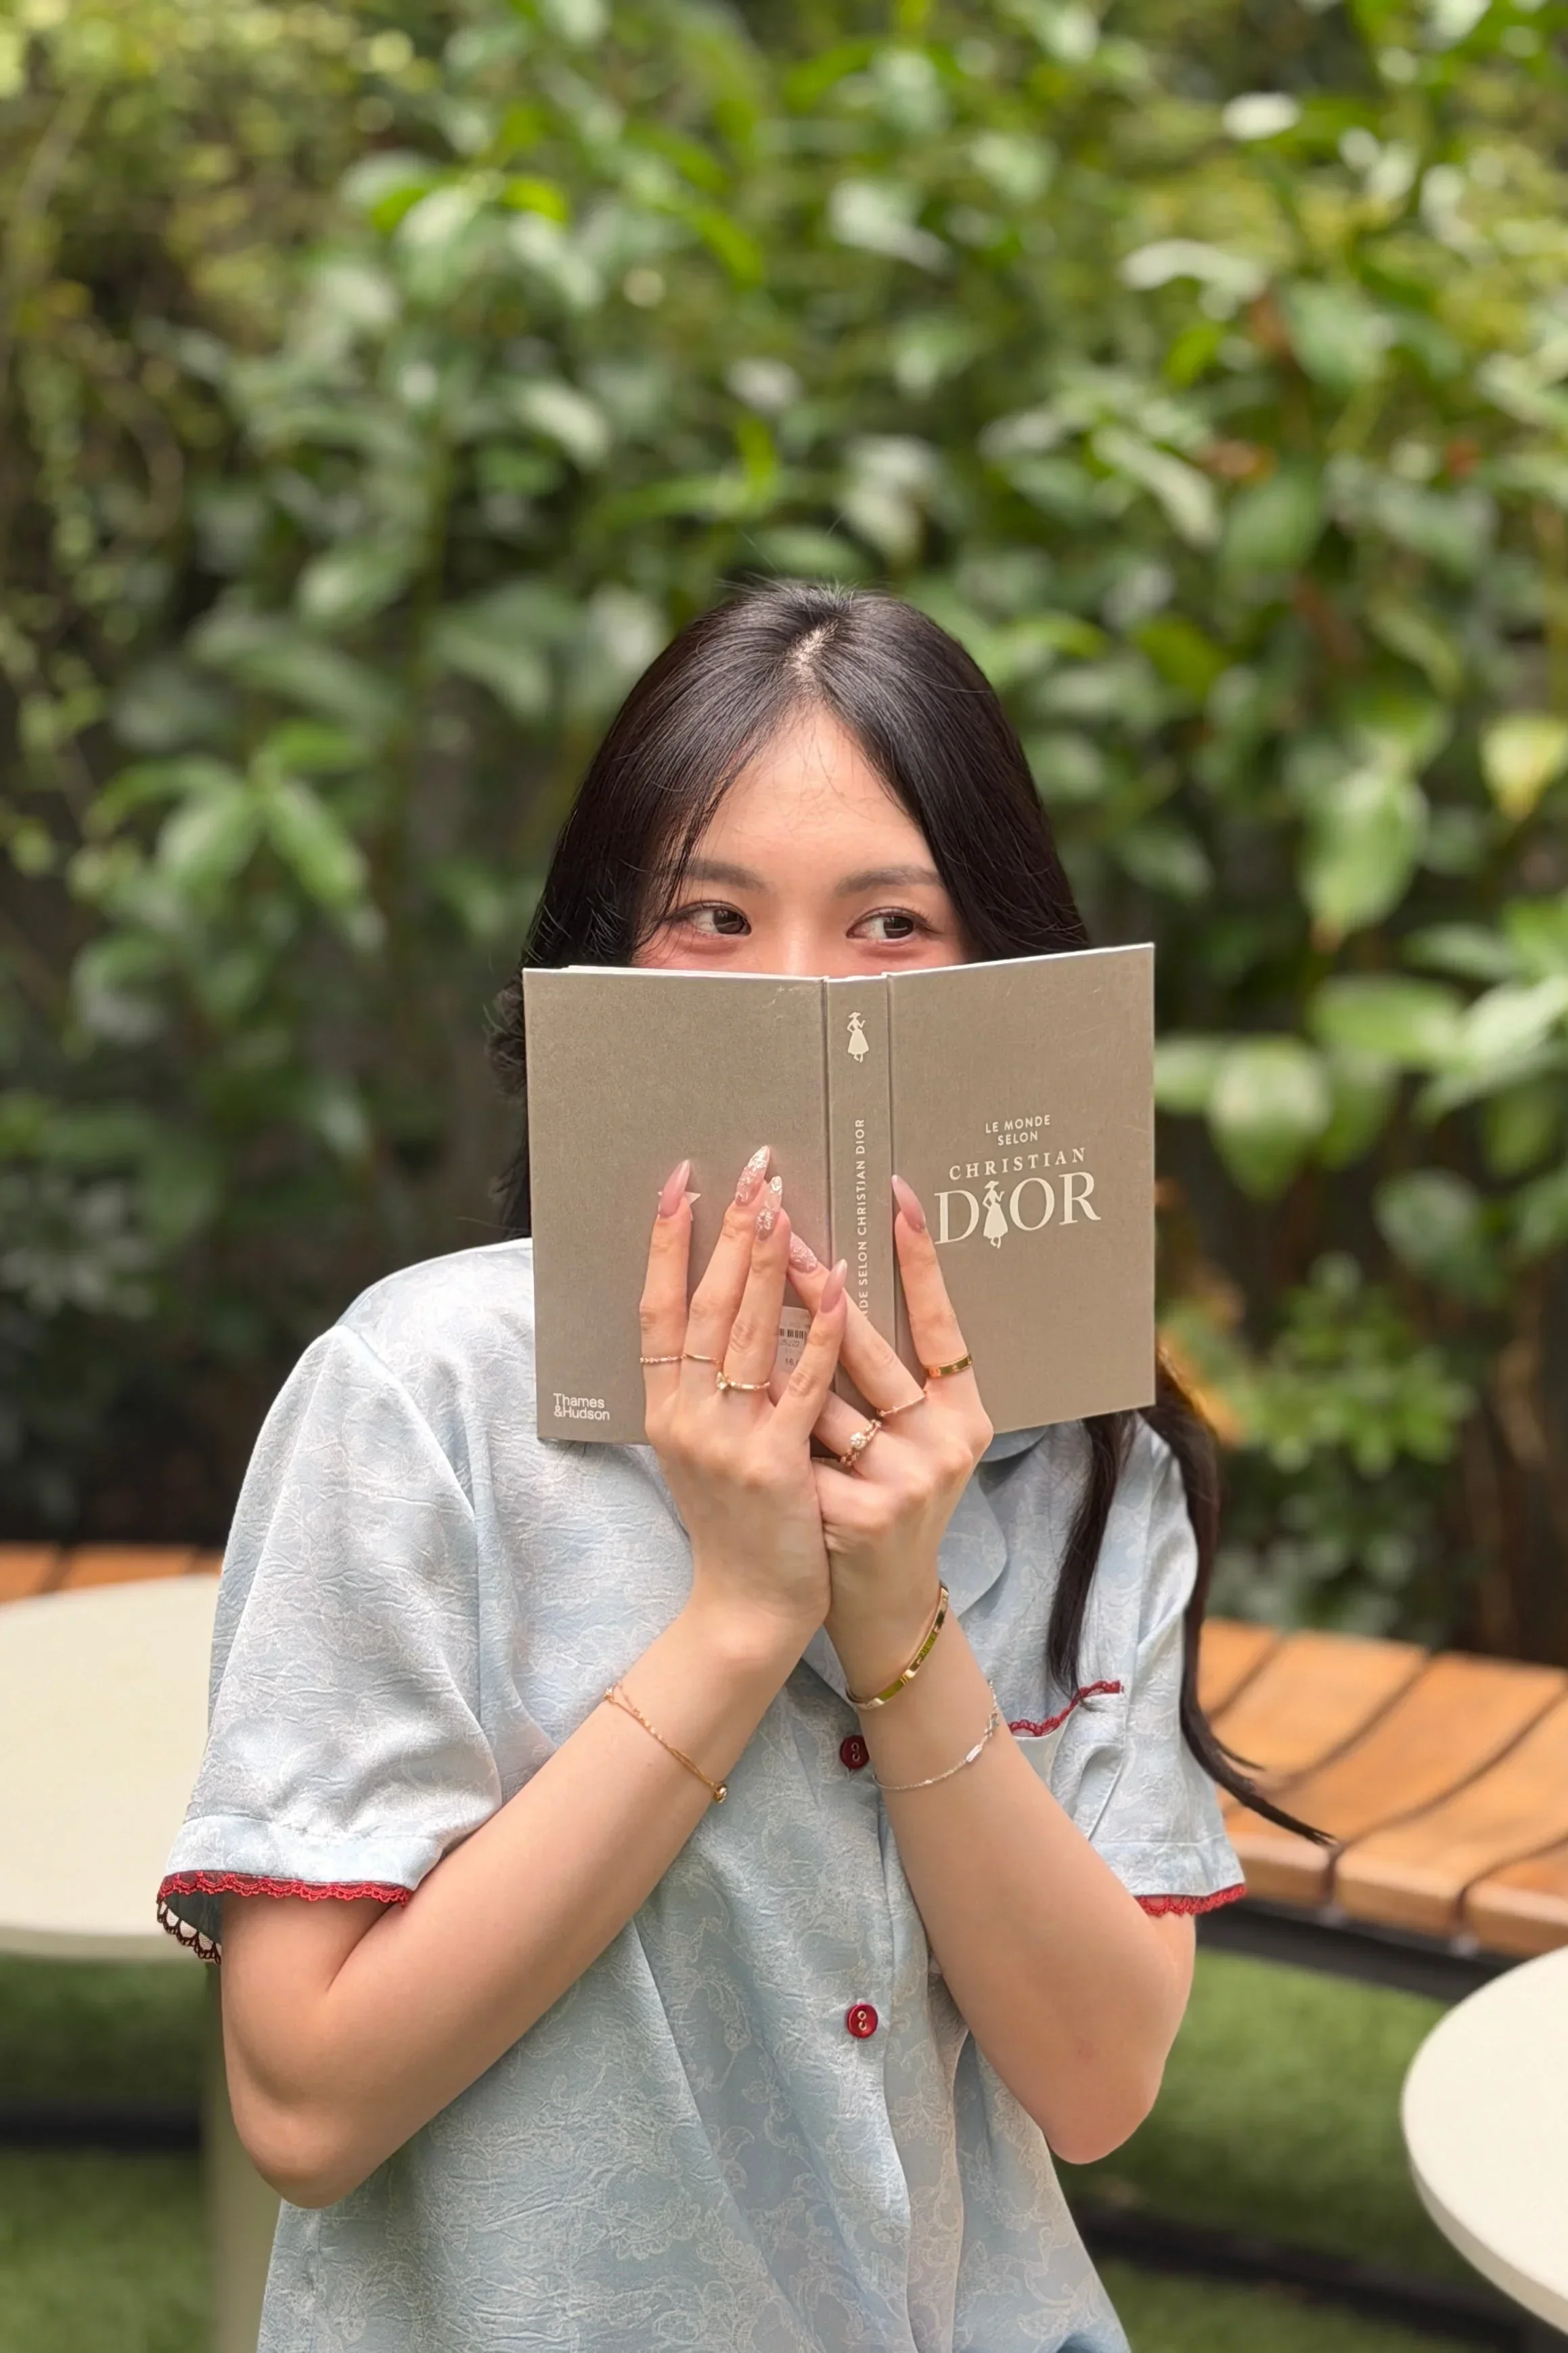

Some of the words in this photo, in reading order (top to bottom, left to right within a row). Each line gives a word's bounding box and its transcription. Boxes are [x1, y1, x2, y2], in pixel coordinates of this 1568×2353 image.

[855, 1118, 866, 1155] DIOR
[985, 1122, 999, 1134] LE
[1004, 1115, 1051, 1131] MONDE
[998, 1131, 1038, 1146] SELON
[949, 1147, 1086, 1181] CHRISTIAN
[856, 1160, 867, 1236] CHRISTIAN
[858, 1241, 868, 1285] SELON
[553, 1393, 605, 1409] Thames
[554, 1405, 610, 1421] &Hudson
